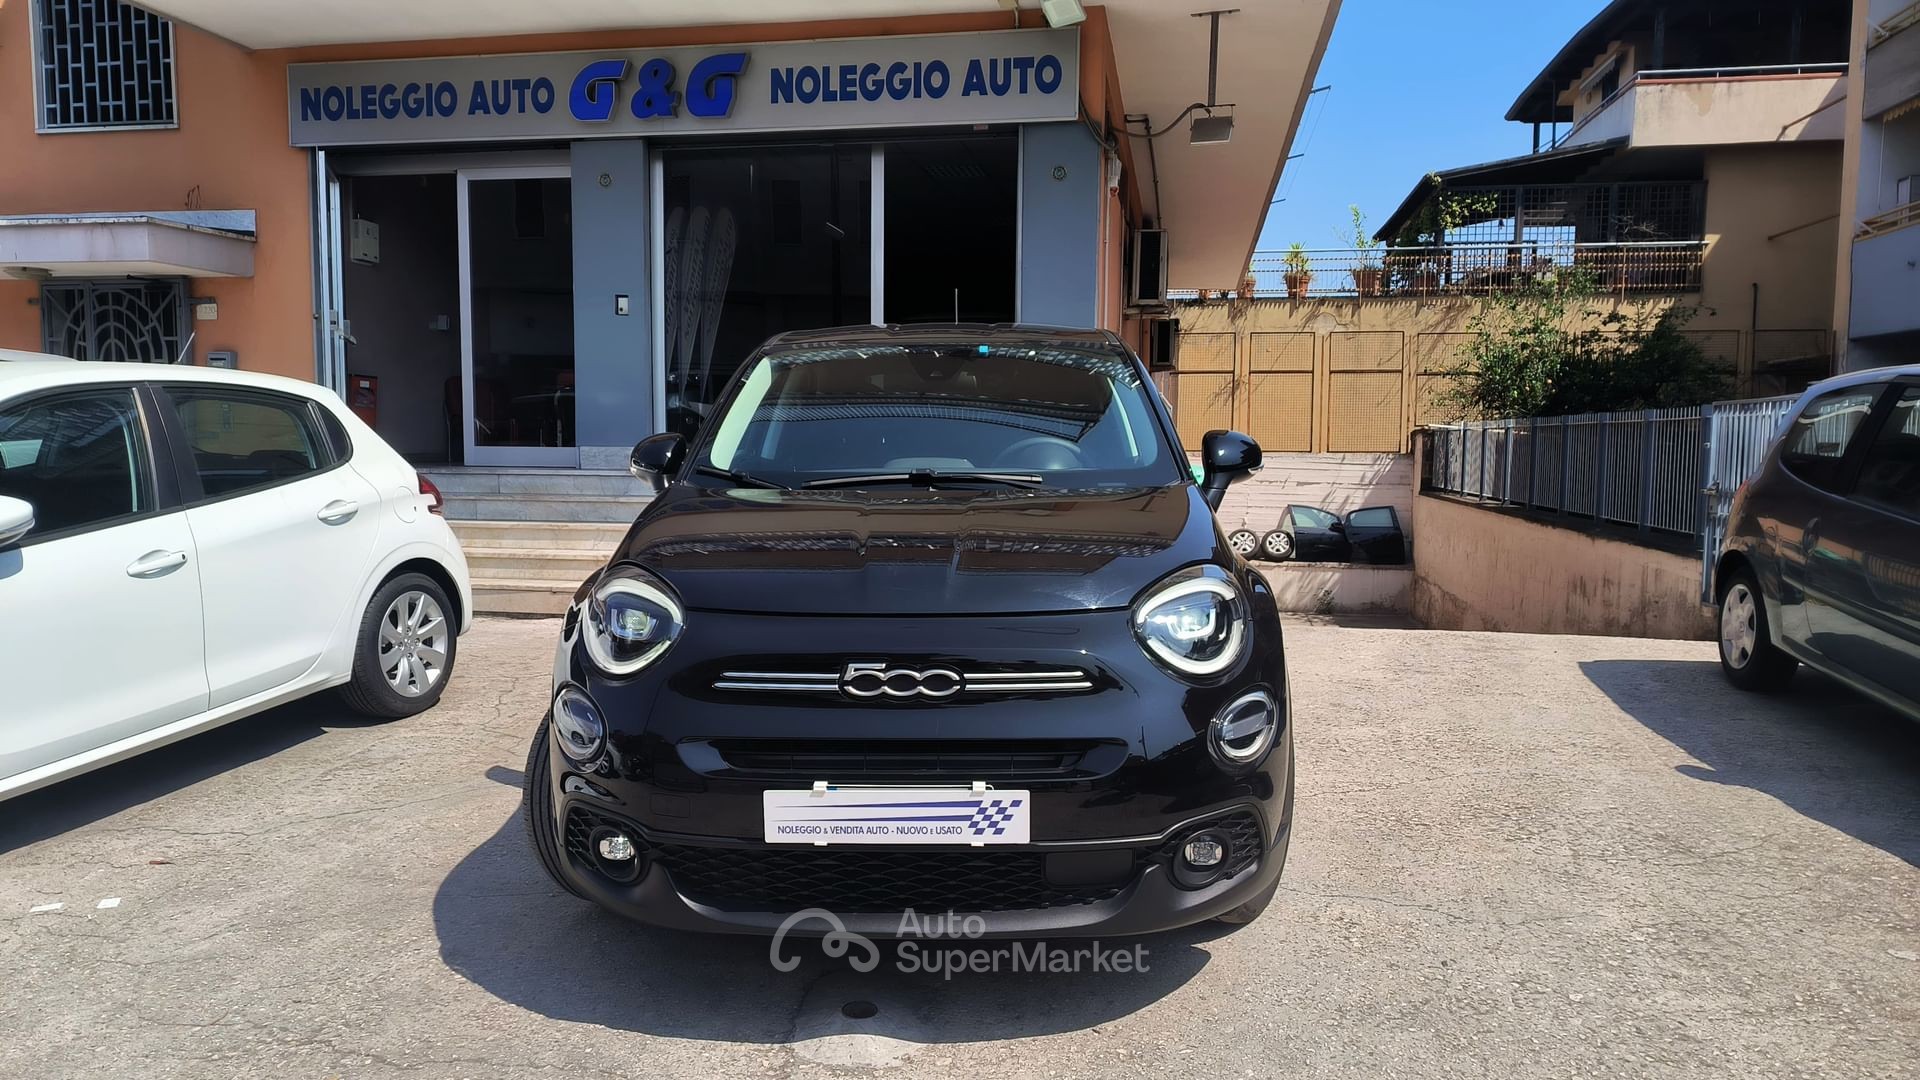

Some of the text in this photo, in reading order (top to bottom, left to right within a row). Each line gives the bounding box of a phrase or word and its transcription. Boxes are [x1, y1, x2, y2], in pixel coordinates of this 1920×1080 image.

[301, 53, 1062, 122] NOLEGGIO AUTO G&G NOLEGGIO AUTO
[843, 663, 960, 696] 500
[777, 825, 821, 835] NOLEGGIO
[830, 825, 865, 835] VENDITA
[866, 825, 889, 835] AUTO
[896, 825, 929, 835] NUOVO
[935, 825, 963, 835] USATO
